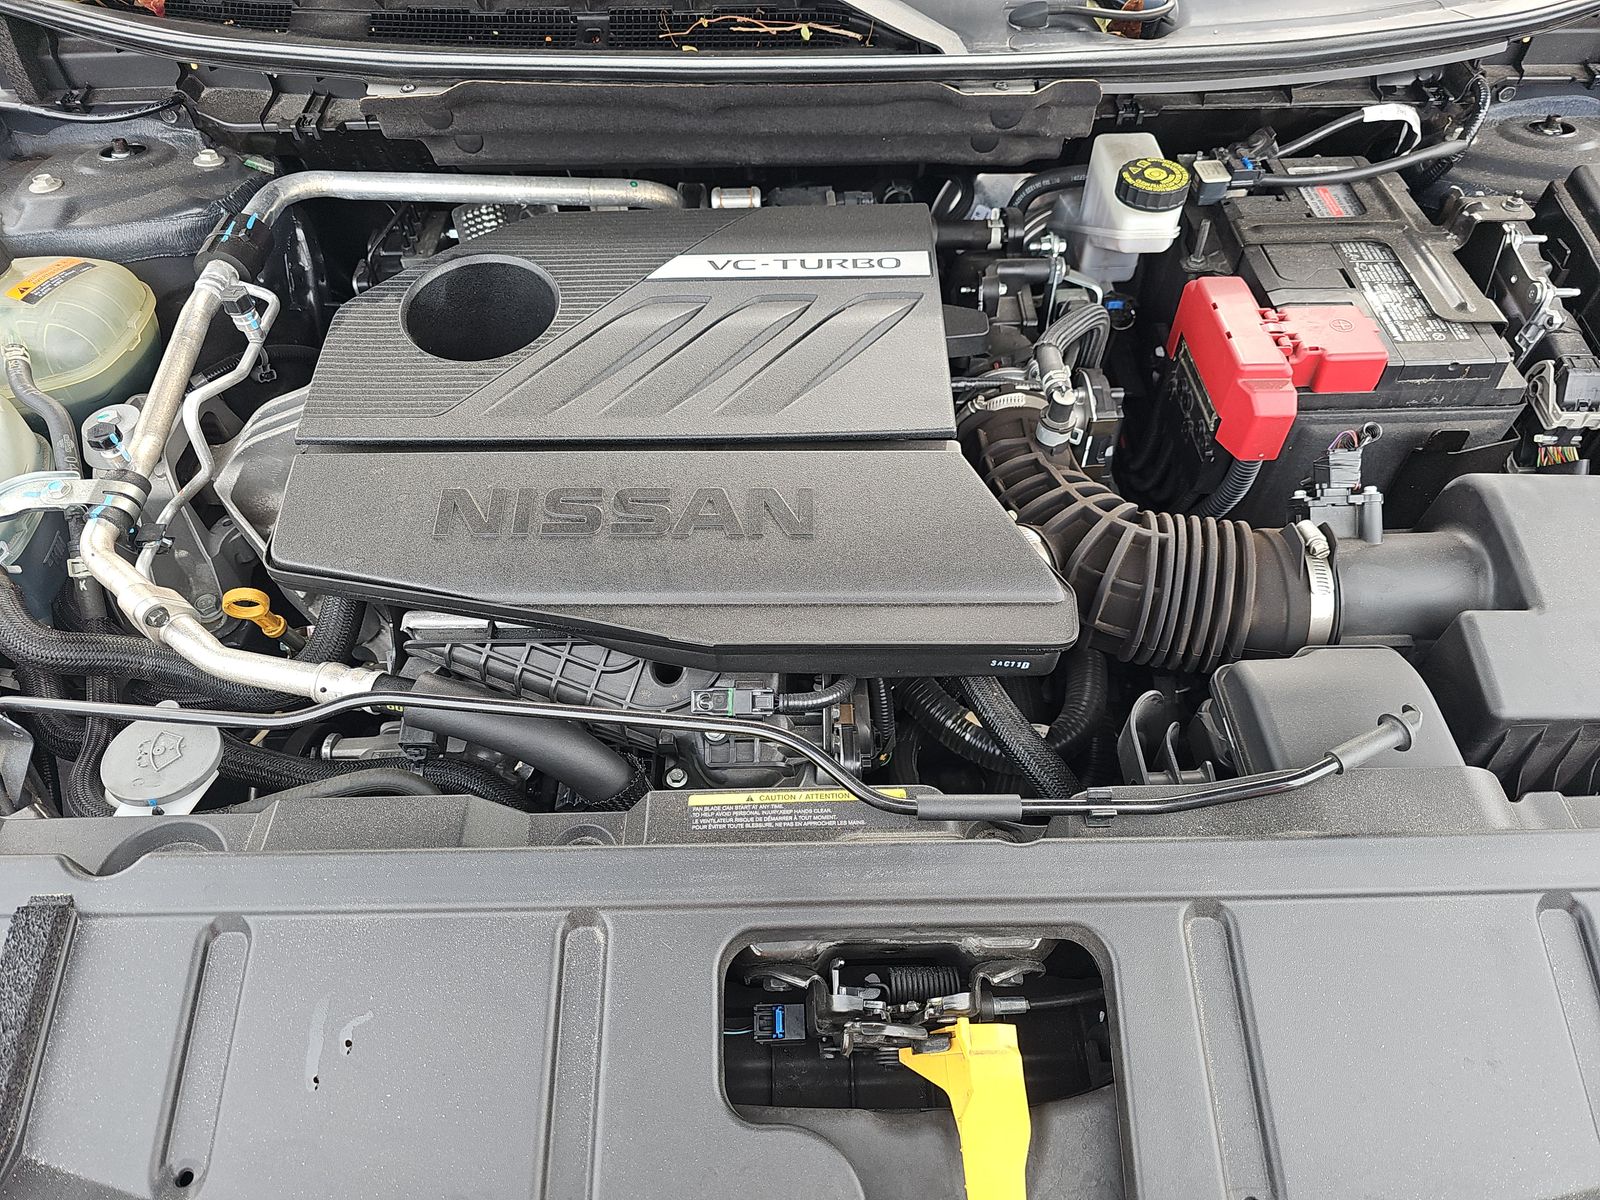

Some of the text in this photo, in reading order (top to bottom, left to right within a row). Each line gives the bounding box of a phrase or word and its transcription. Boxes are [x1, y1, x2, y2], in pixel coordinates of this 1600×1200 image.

[707, 257, 901, 271] VC-TURBO
[432, 487, 815, 538] NISSAN
[79, 579, 88, 591] K
[805, 792, 850, 800] ATTENTION
